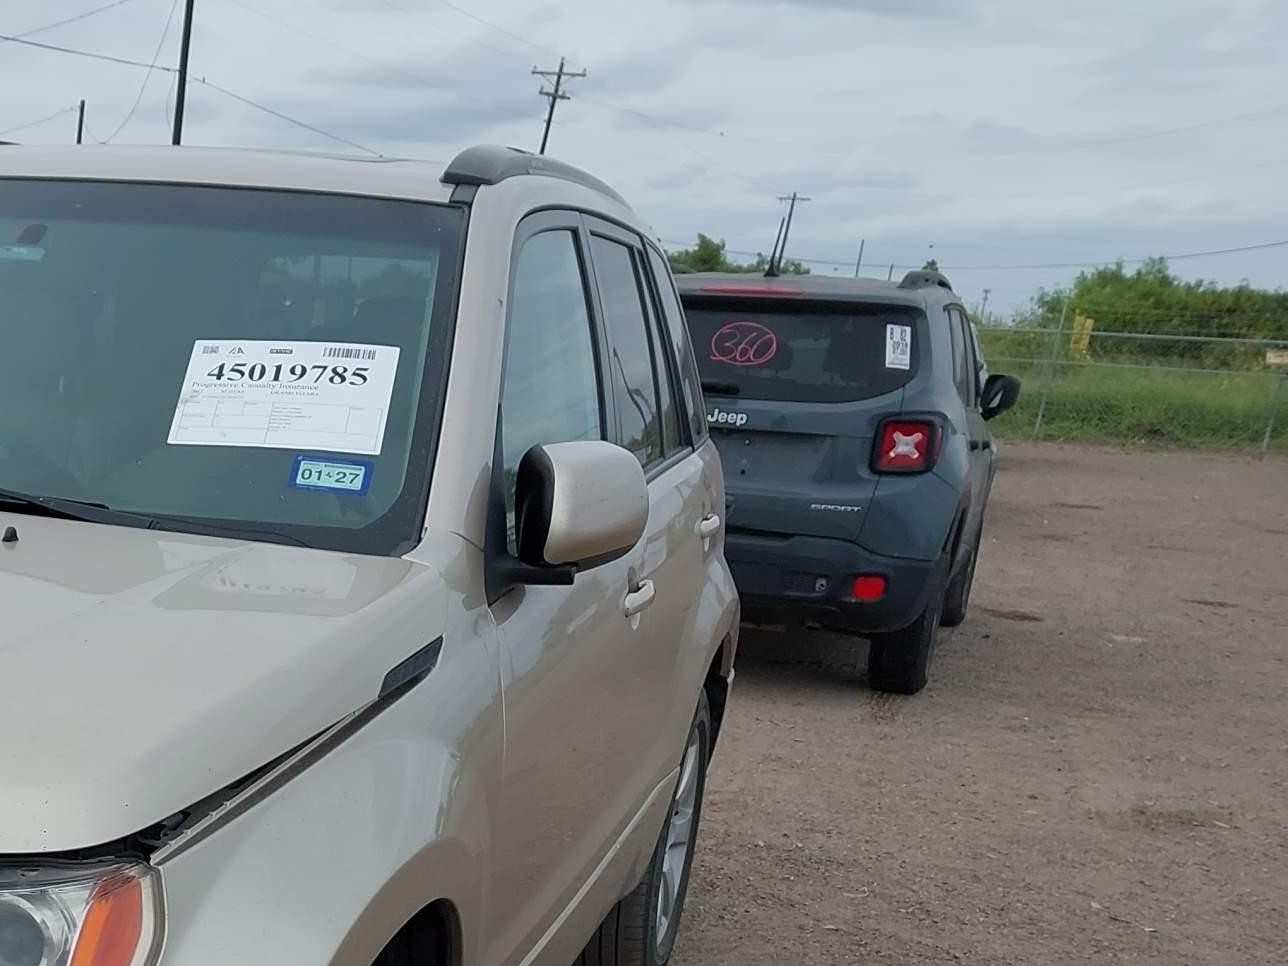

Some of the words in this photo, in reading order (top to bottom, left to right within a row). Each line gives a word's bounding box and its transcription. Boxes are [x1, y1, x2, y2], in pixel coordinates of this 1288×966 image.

[710, 329, 777, 361] 360
[207, 361, 370, 386] 45019785
[706, 408, 748, 426] Jeep
[301, 468, 322, 481] 01
[334, 471, 360, 484] 27
[811, 503, 862, 512] SPORT
